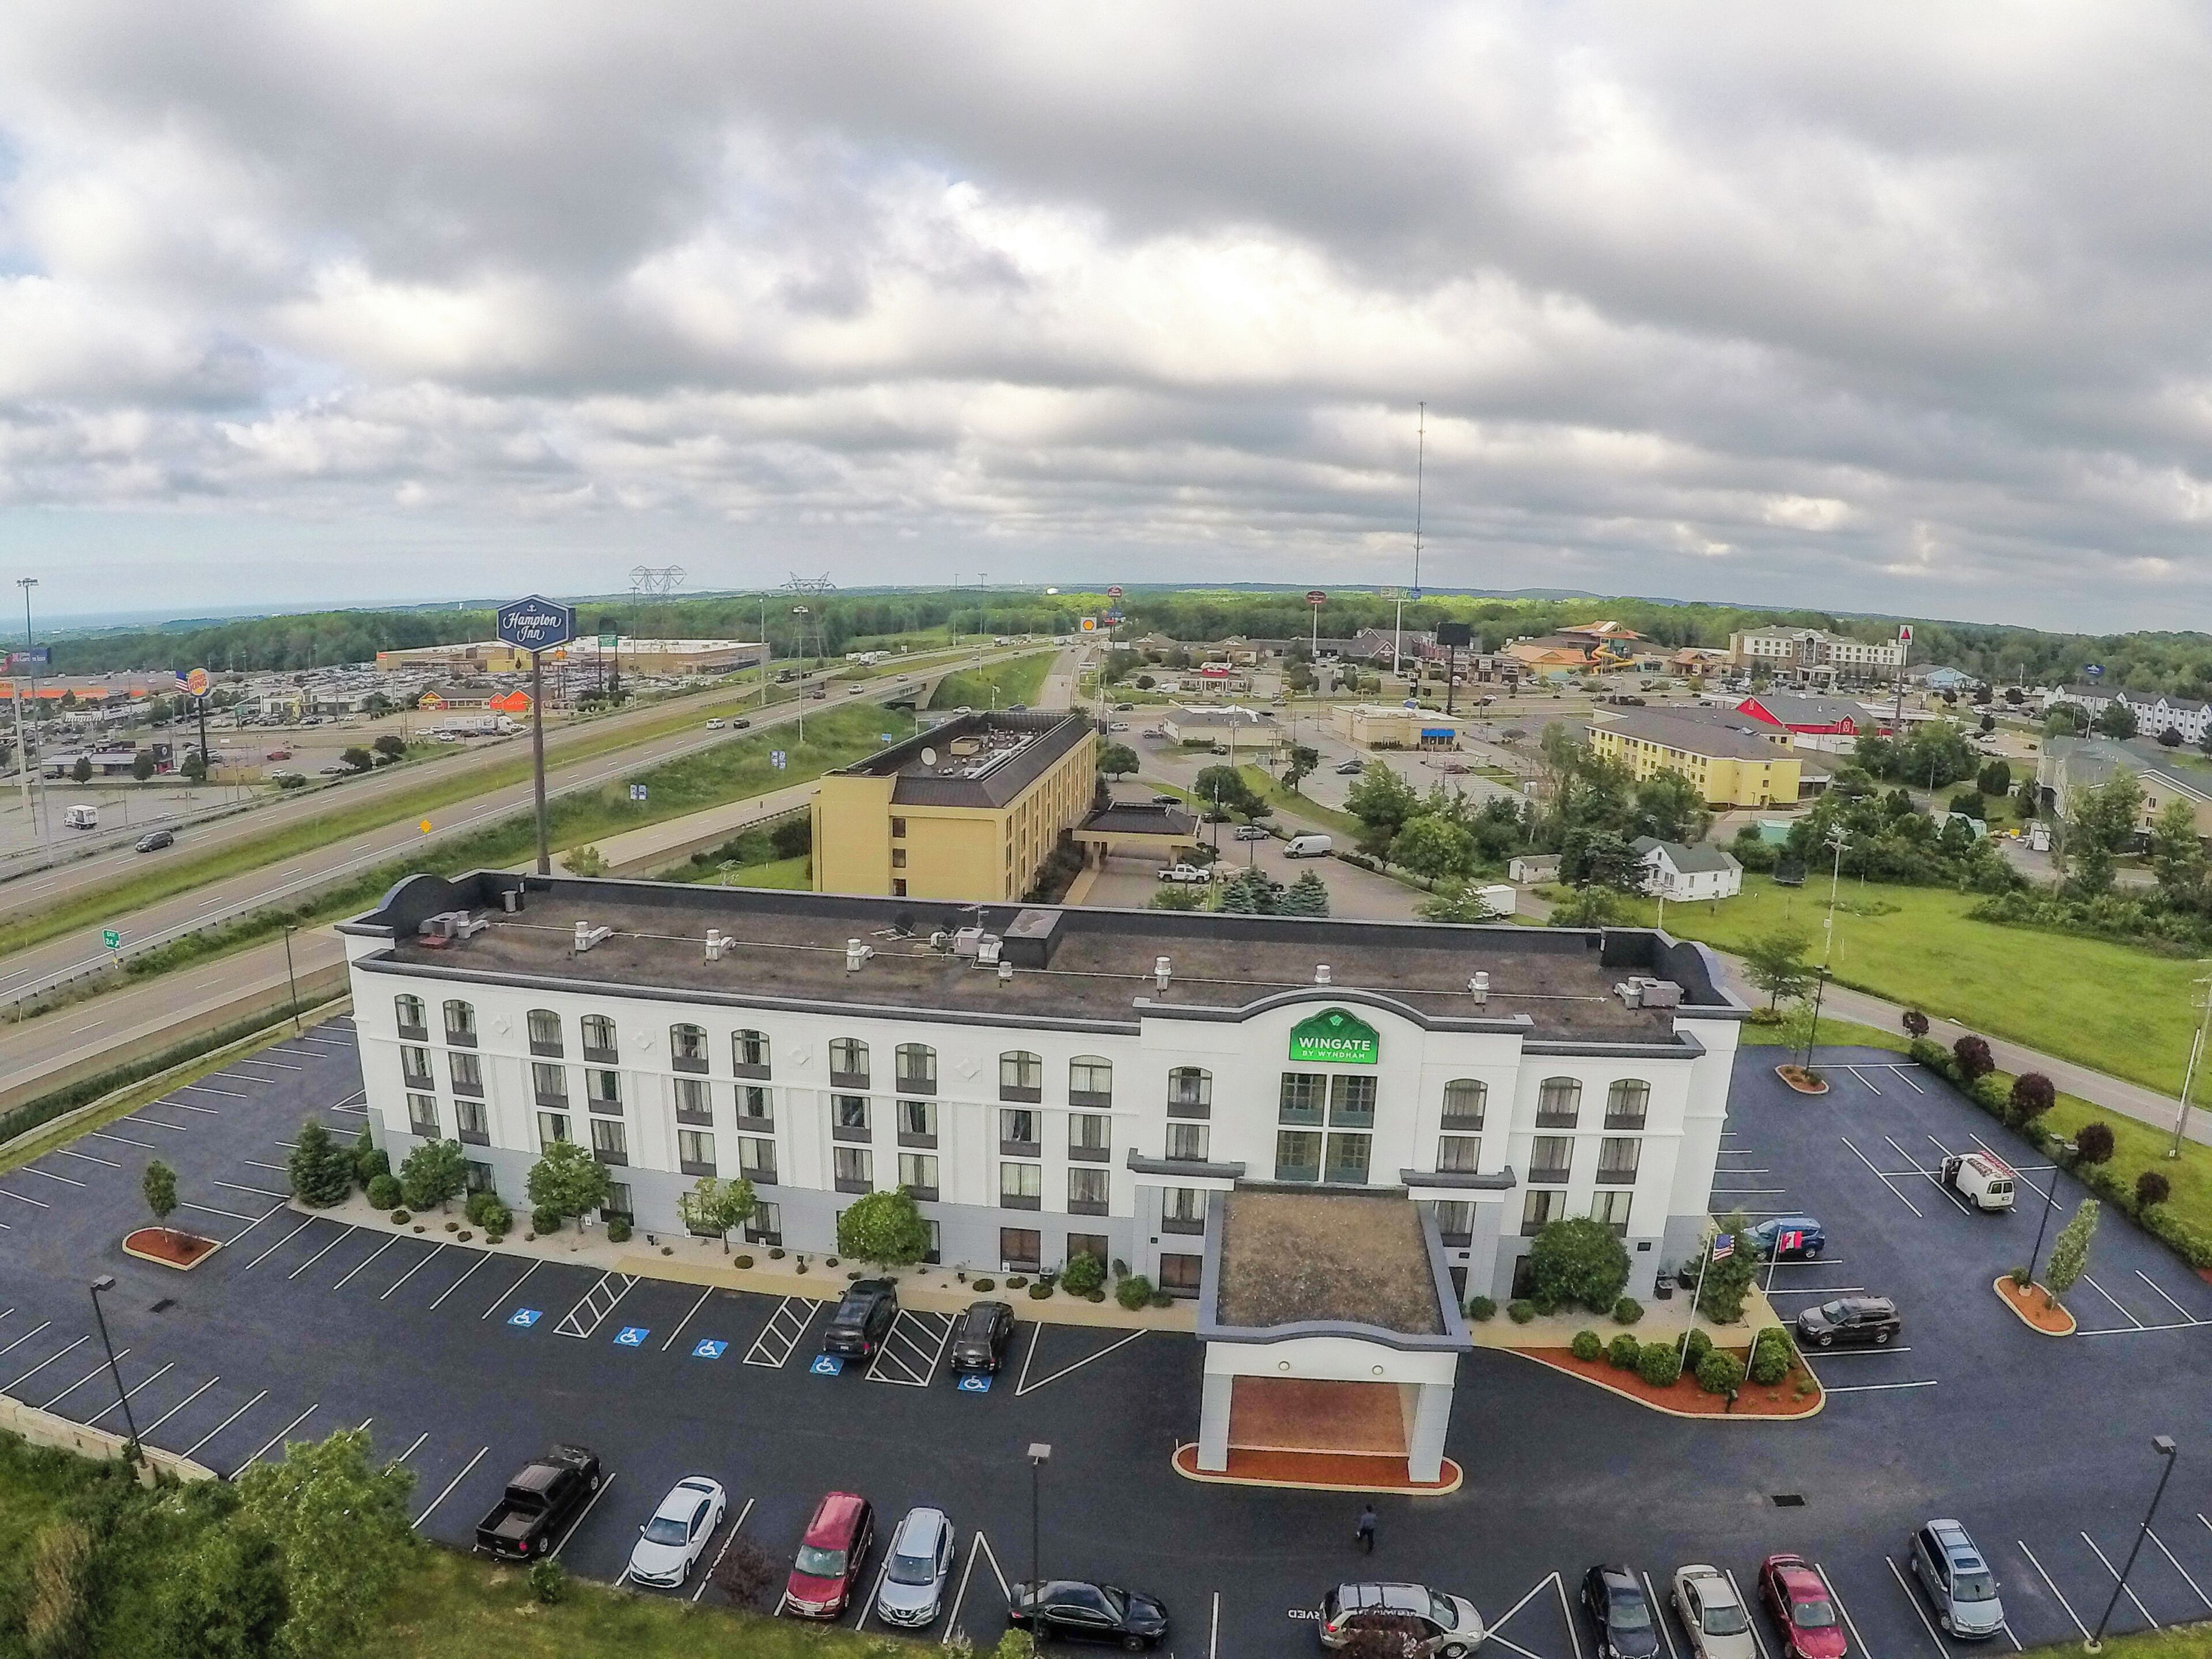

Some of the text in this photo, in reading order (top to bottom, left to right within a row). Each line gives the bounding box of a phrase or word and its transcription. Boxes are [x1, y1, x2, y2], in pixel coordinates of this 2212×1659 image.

[503, 612, 562, 629] Hampton
[517, 626, 545, 642] Inn
[190, 679, 207, 692] KING
[1298, 1037, 1371, 1051] WINGATE
[1318, 1051, 1365, 1059] WYNDHAM
